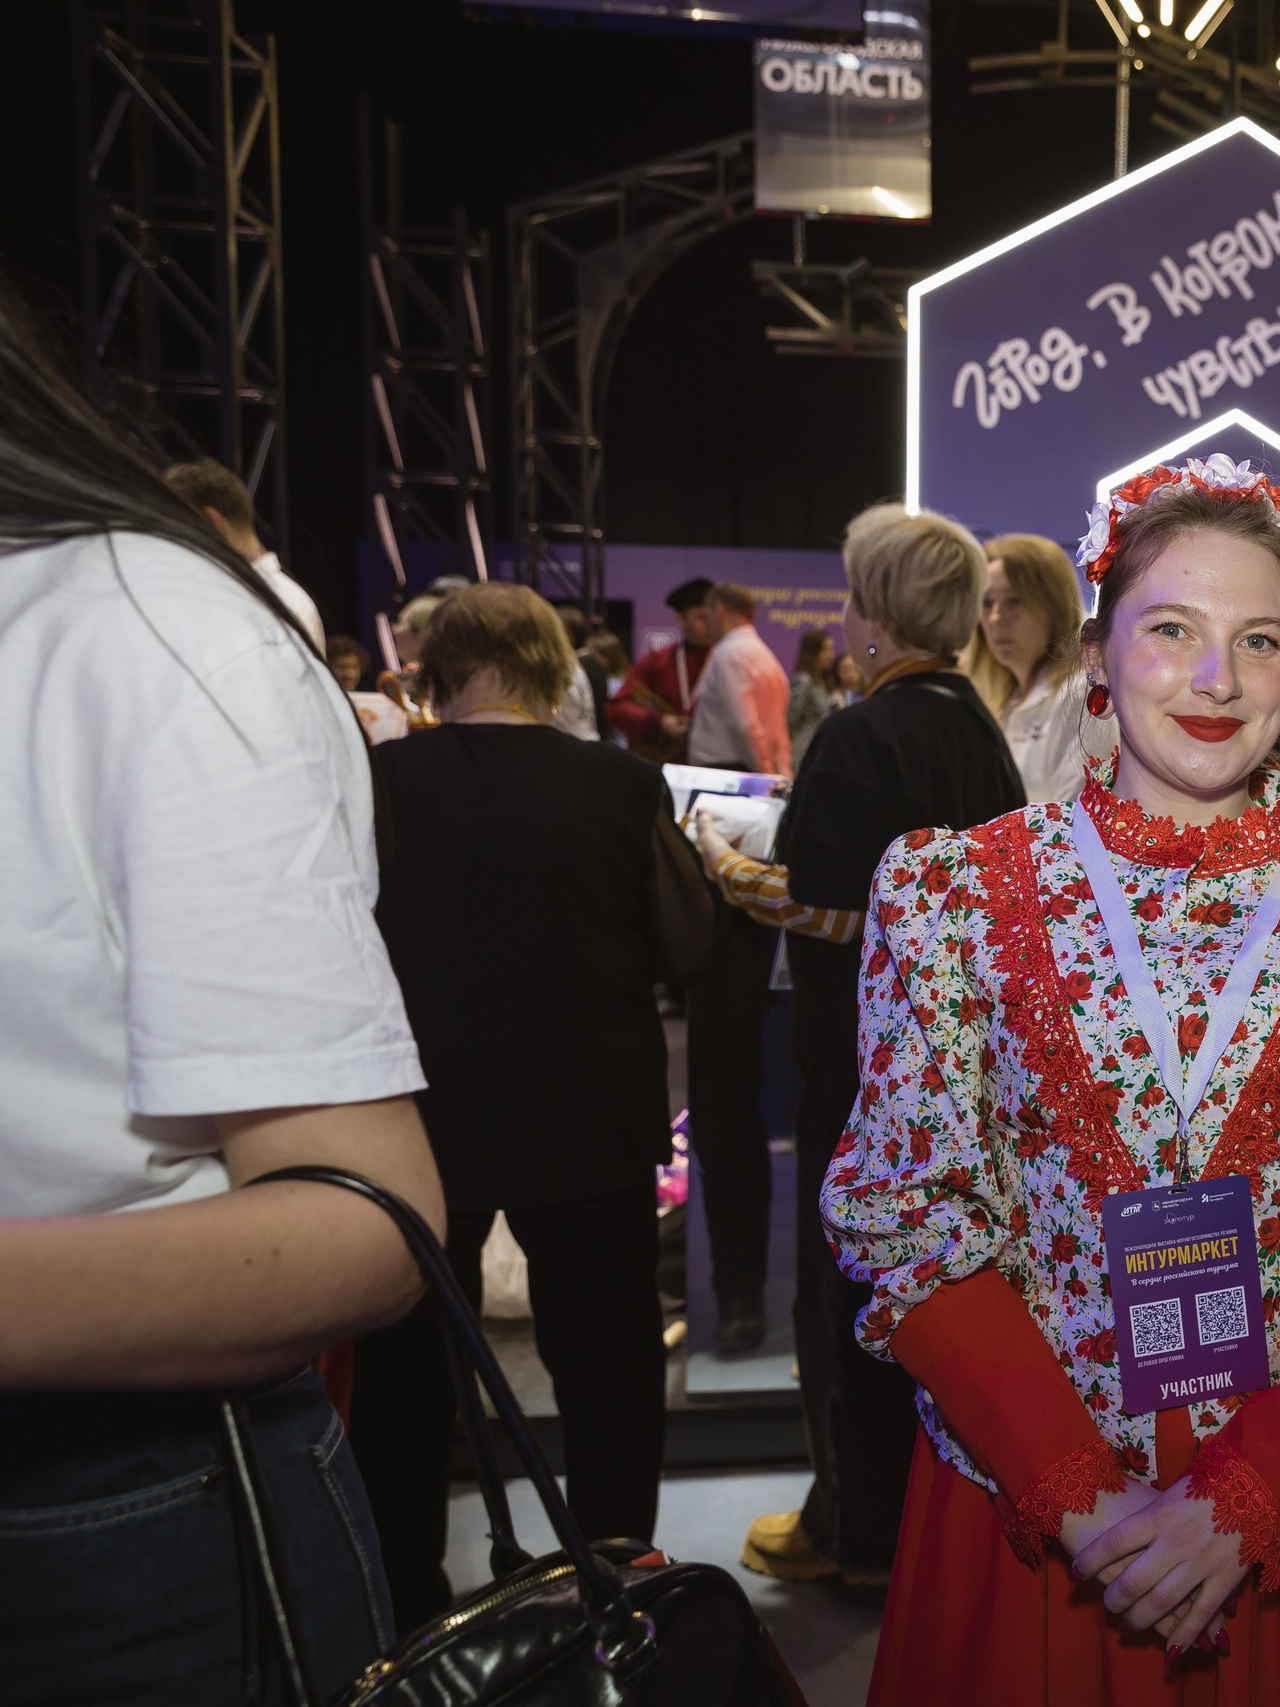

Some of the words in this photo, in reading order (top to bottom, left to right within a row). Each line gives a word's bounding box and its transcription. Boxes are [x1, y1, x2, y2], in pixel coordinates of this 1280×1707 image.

[760, 57, 924, 100] ОБЛАСТЬ
[1122, 1204, 1142, 1216] ИТМ
[1125, 1236, 1239, 1274] ИНТУРМАРКЕТ
[1138, 1276, 1162, 1287] сердце
[1163, 1268, 1206, 1283] российского
[1206, 1262, 1239, 1275] туризма
[1213, 1343, 1239, 1353] УЧАСТНИКИ
[1137, 1358, 1158, 1368] ДЕЛОВАЯ
[1158, 1354, 1185, 1364] ПРОГРАММА
[1160, 1370, 1234, 1400] УЧАСТНИК
